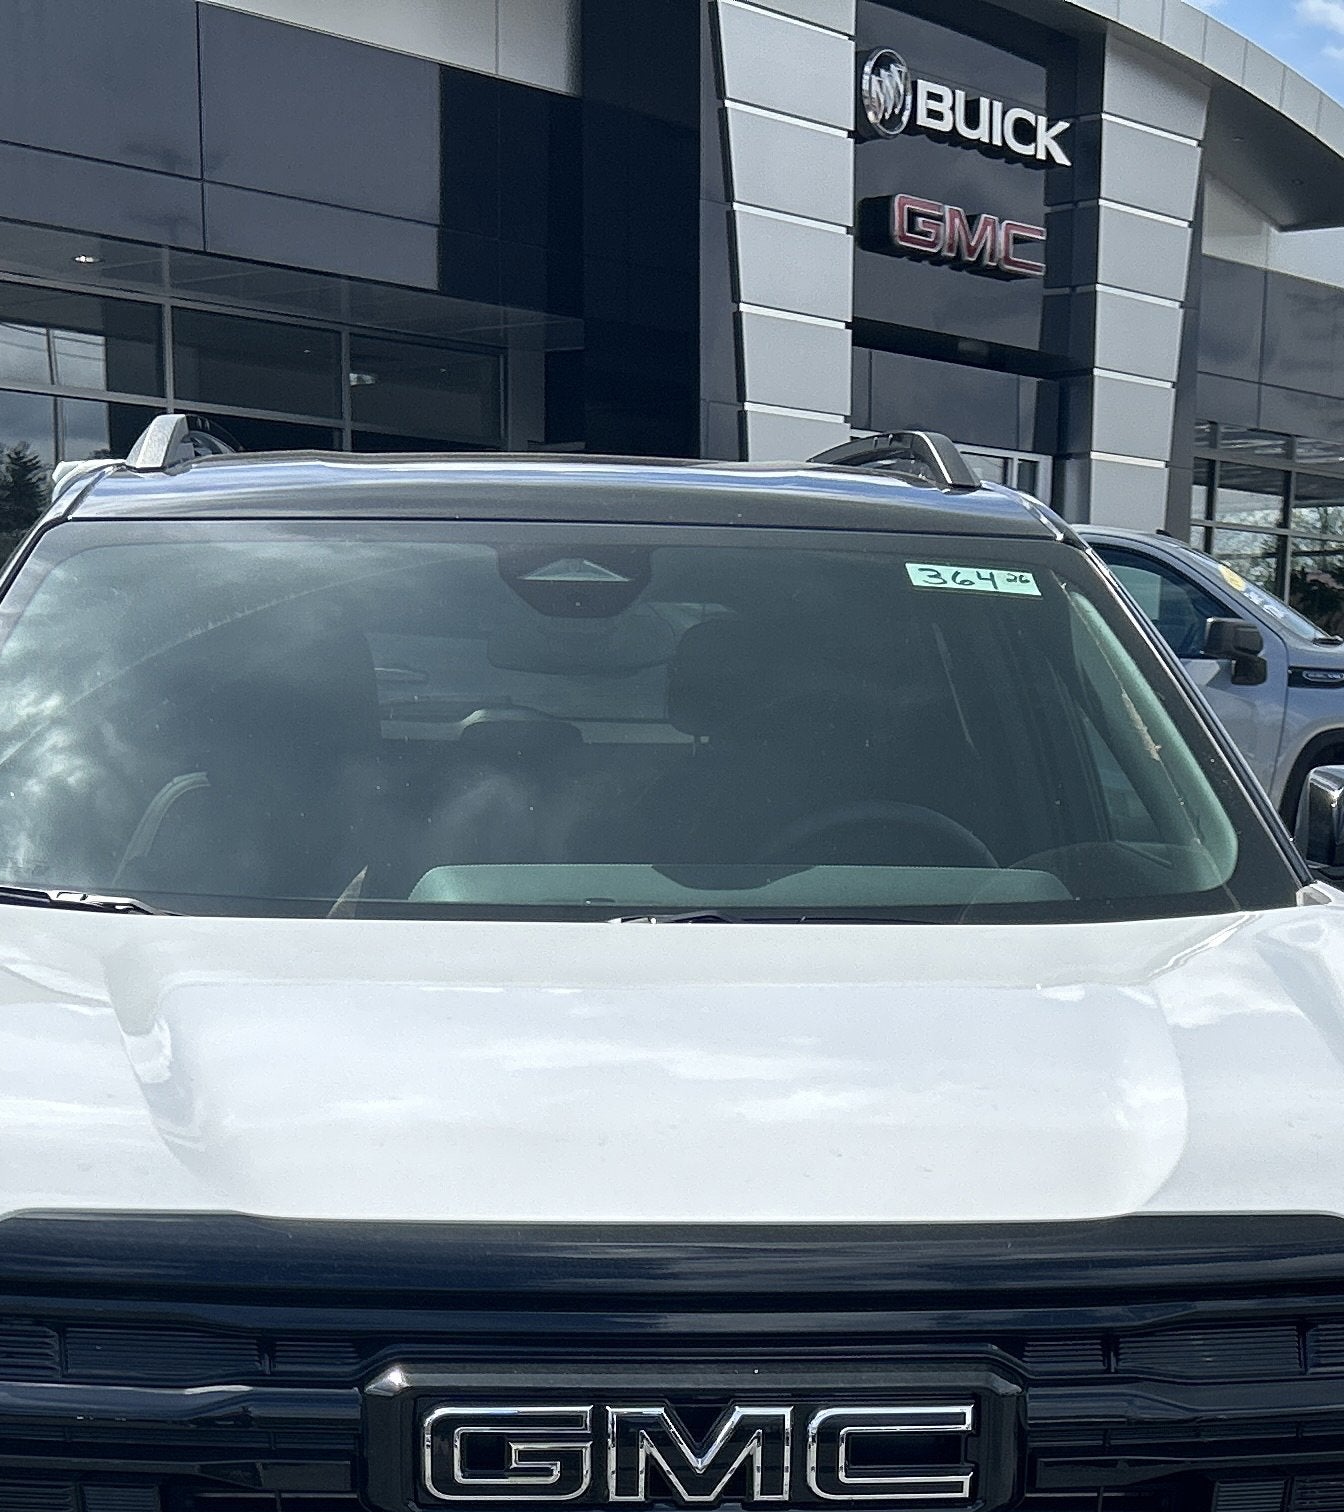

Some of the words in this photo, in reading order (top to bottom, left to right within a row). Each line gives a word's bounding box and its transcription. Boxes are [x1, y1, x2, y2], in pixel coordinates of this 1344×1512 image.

[916, 79, 1072, 167] BUICK
[894, 194, 1047, 276] GMC
[918, 567, 999, 591] 364
[423, 1405, 975, 1501] GMC
